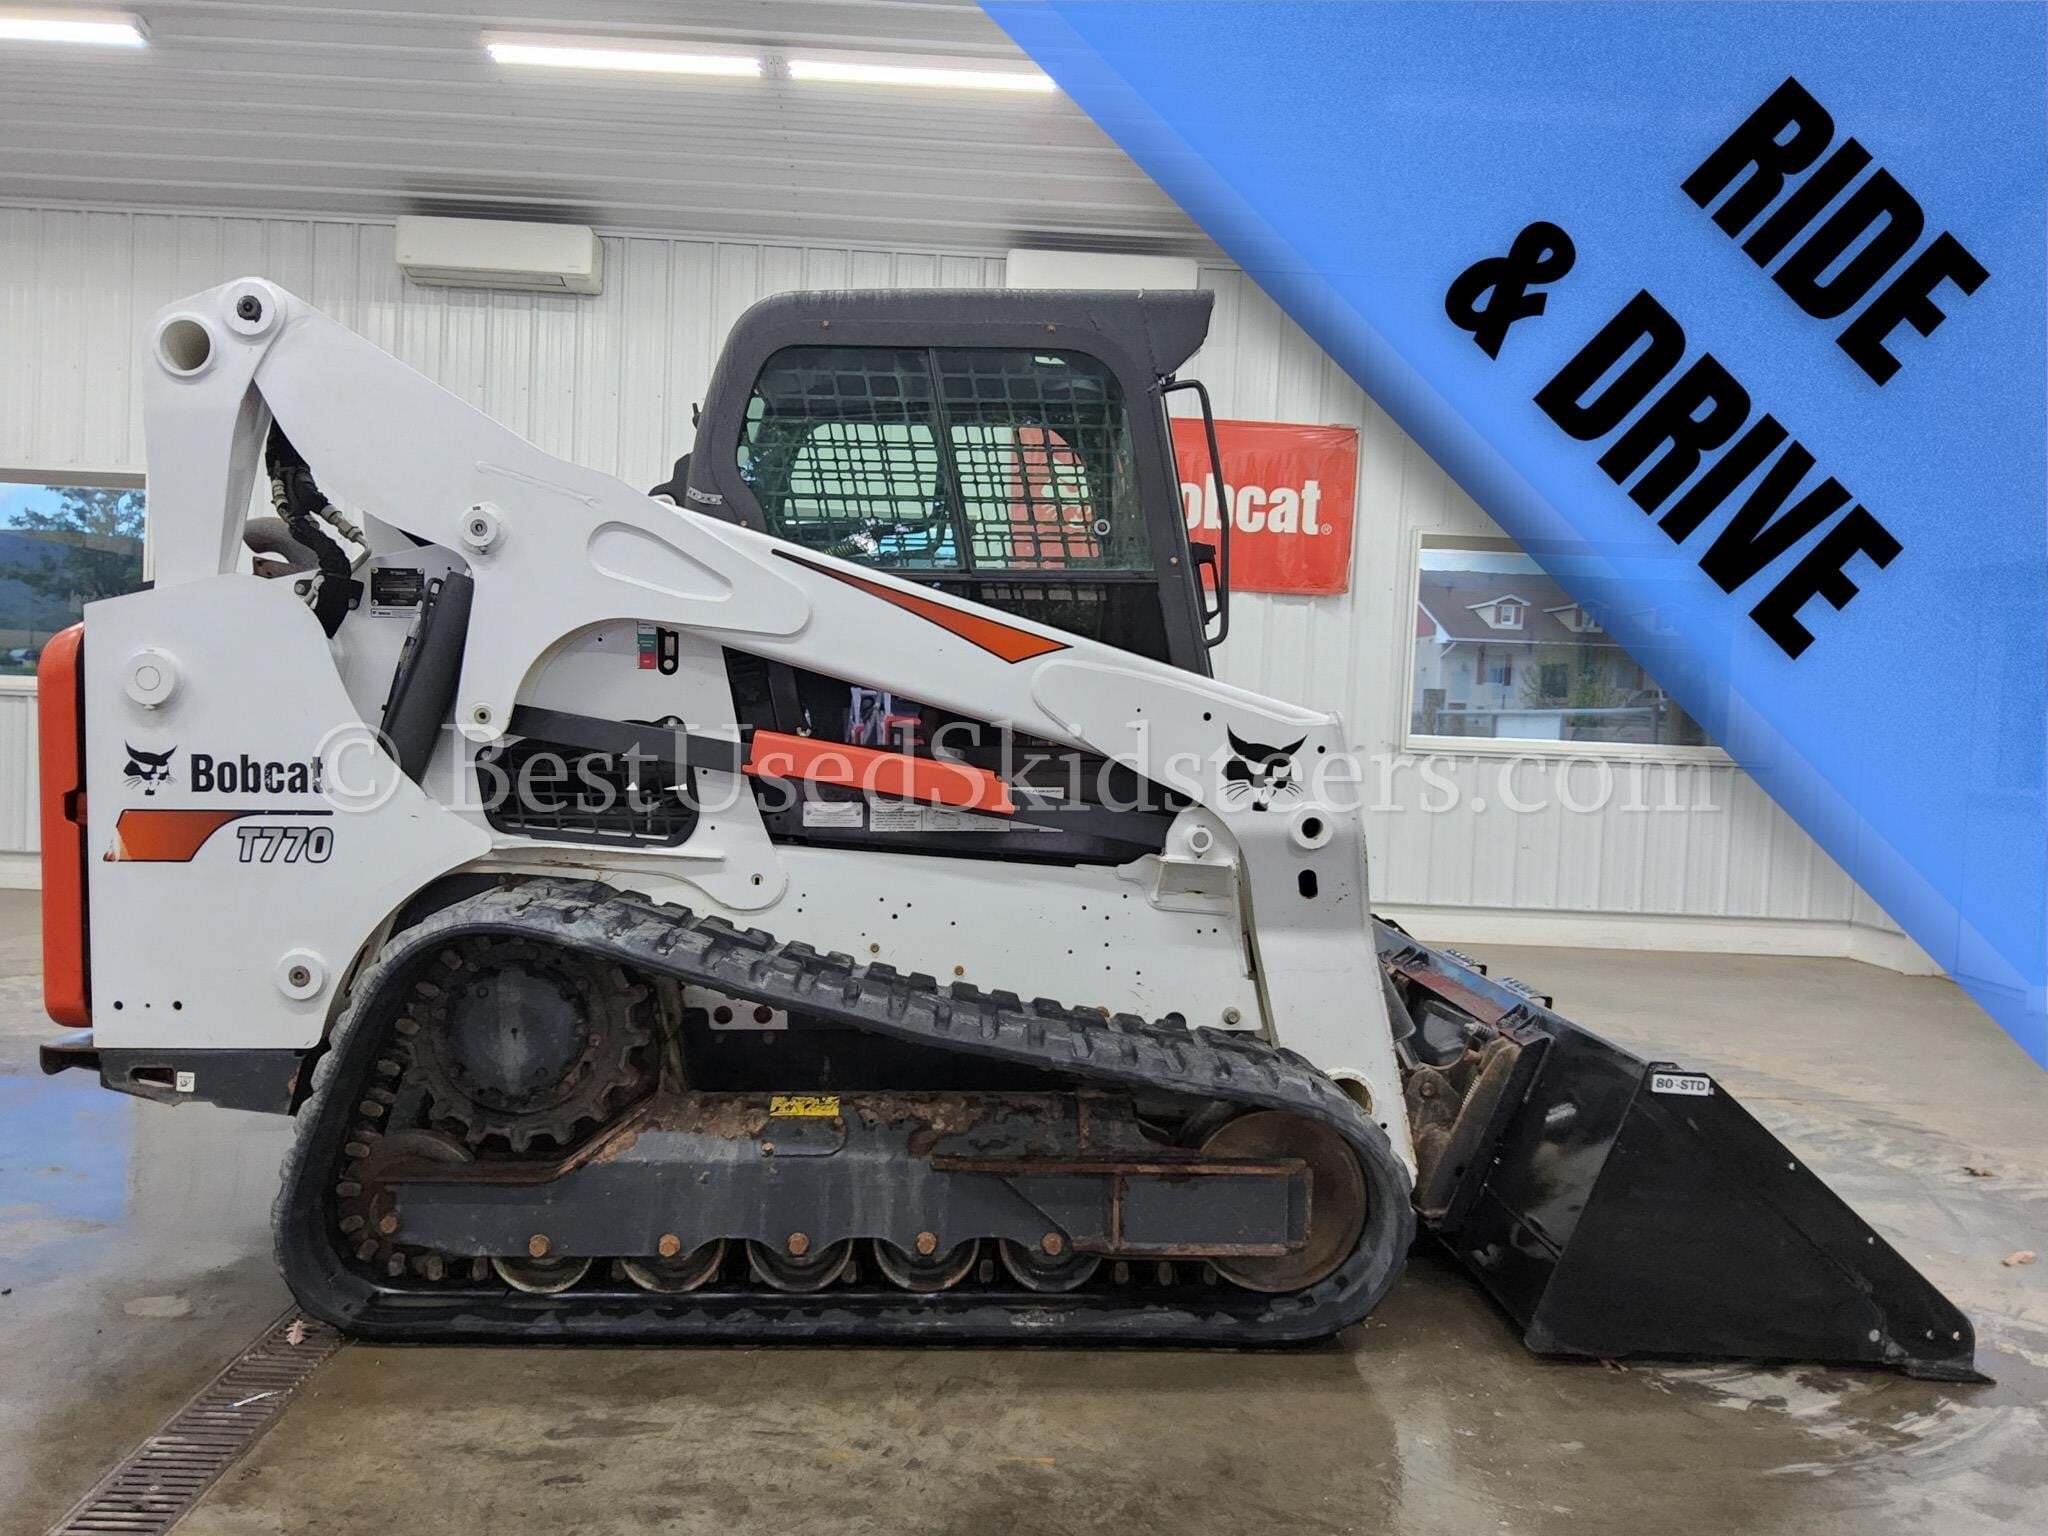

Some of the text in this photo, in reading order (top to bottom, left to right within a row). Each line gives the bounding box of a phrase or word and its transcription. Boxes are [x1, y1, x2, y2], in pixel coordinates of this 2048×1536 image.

[1179, 473, 1321, 535] obcat
[190, 753, 323, 794] Bobcat
[236, 826, 334, 863] T770
